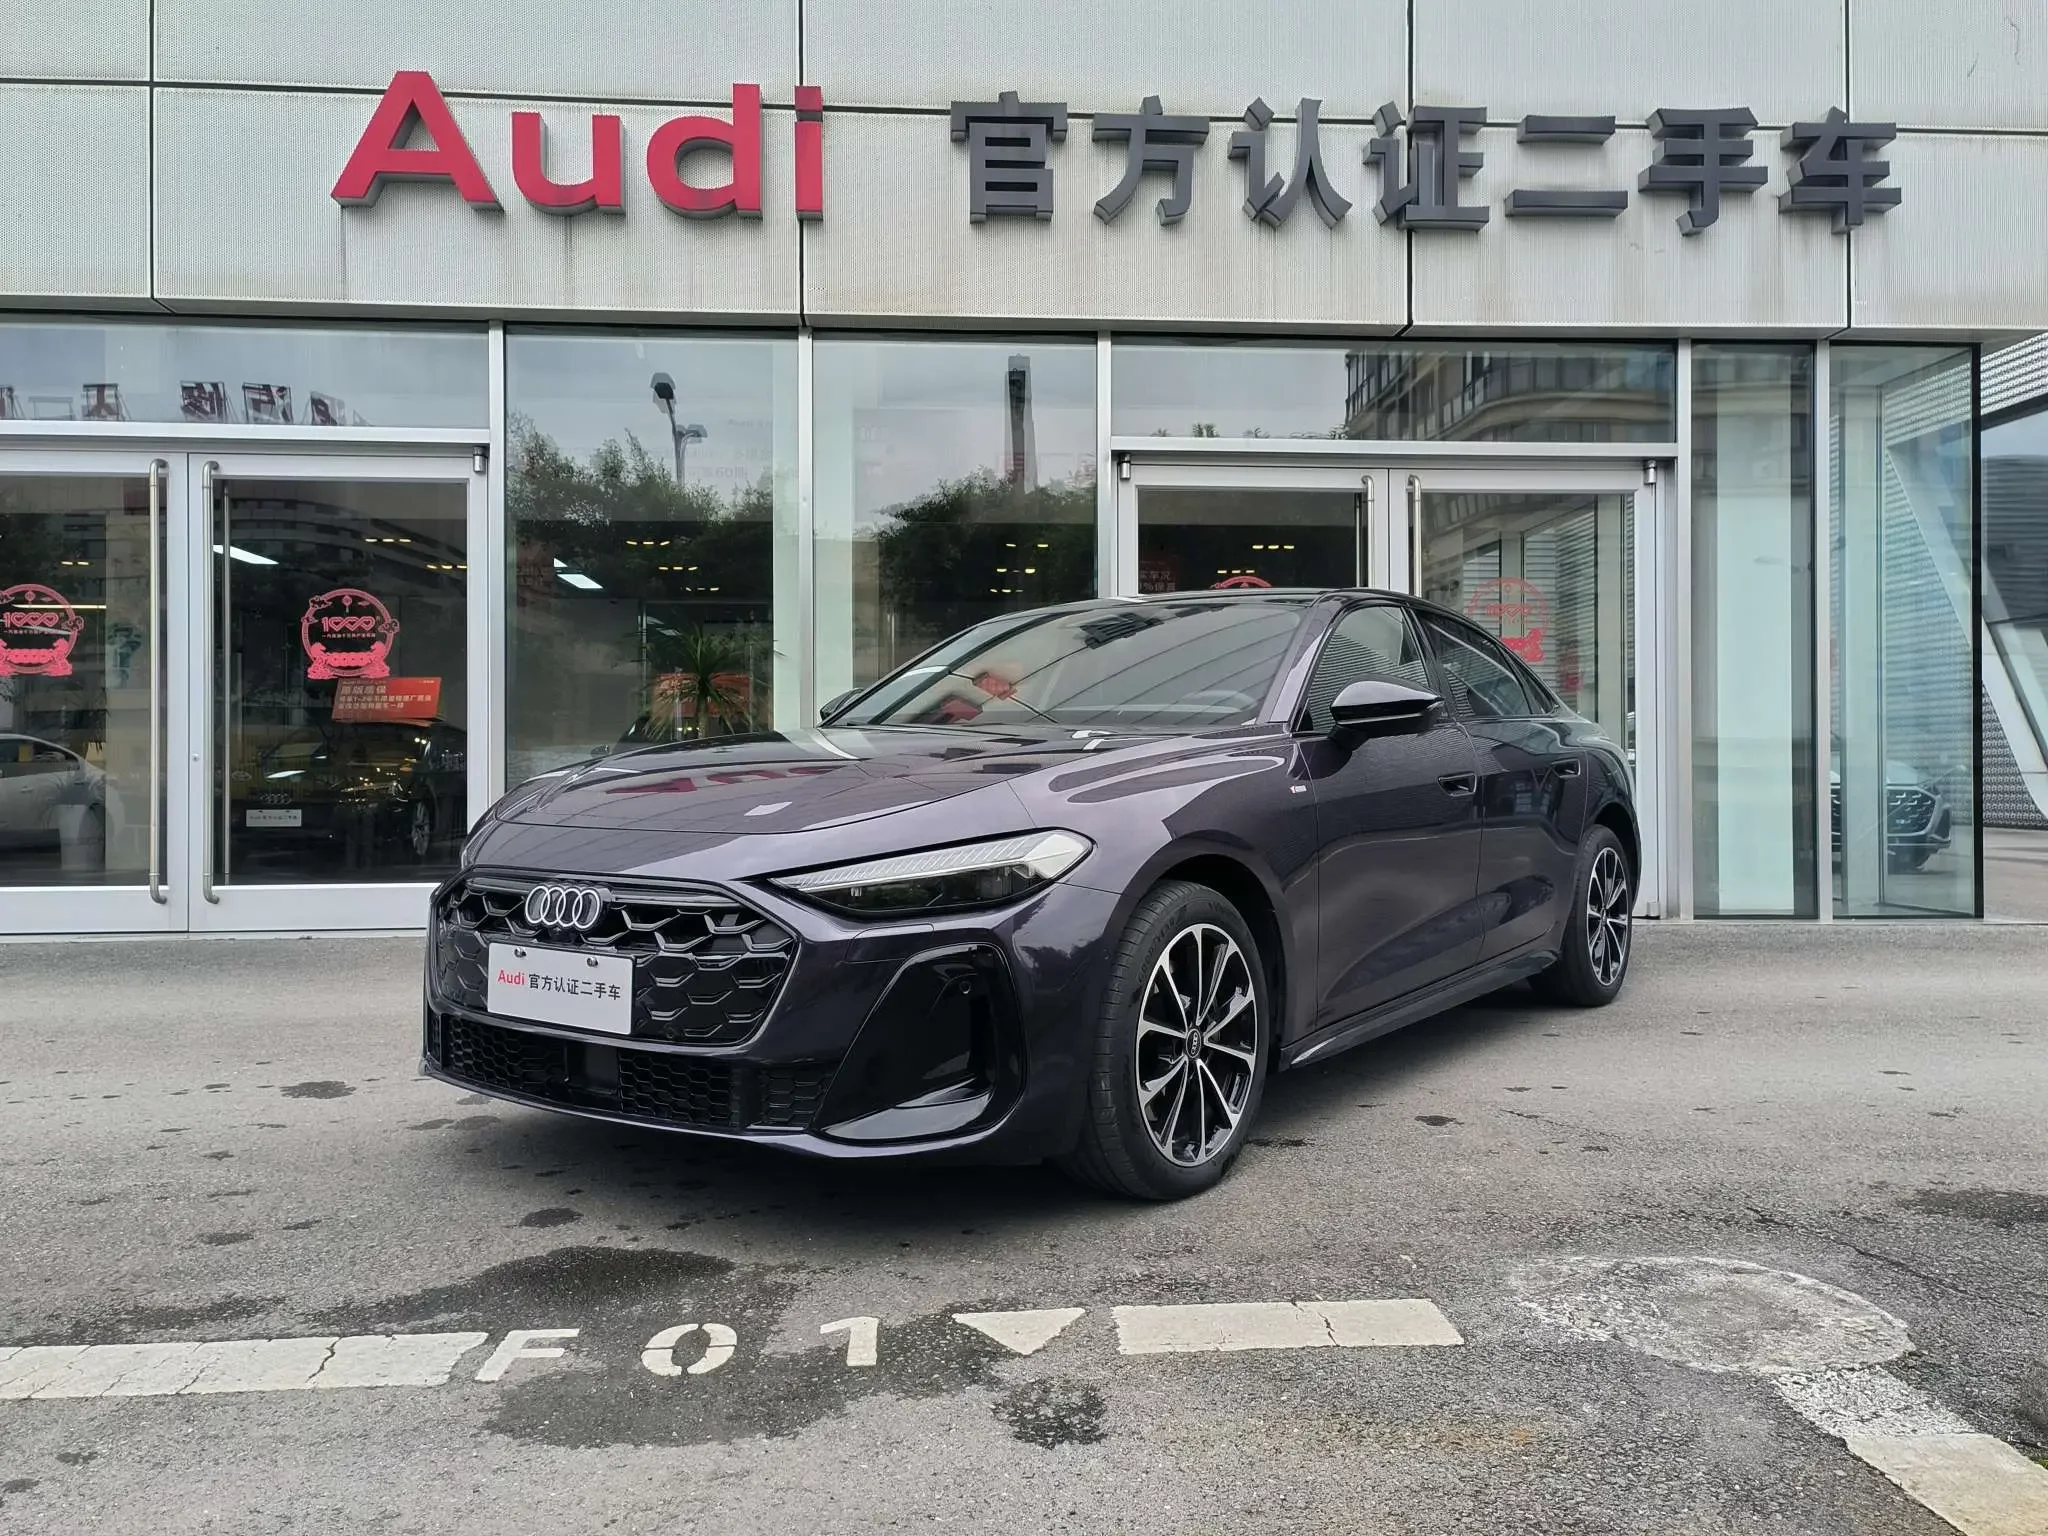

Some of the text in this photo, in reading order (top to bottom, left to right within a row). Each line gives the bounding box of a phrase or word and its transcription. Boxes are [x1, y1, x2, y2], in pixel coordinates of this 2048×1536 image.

[331, 70, 1903, 236] Audi 官方认证二手车
[497, 970, 622, 1001] Audi 官方认证二手车
